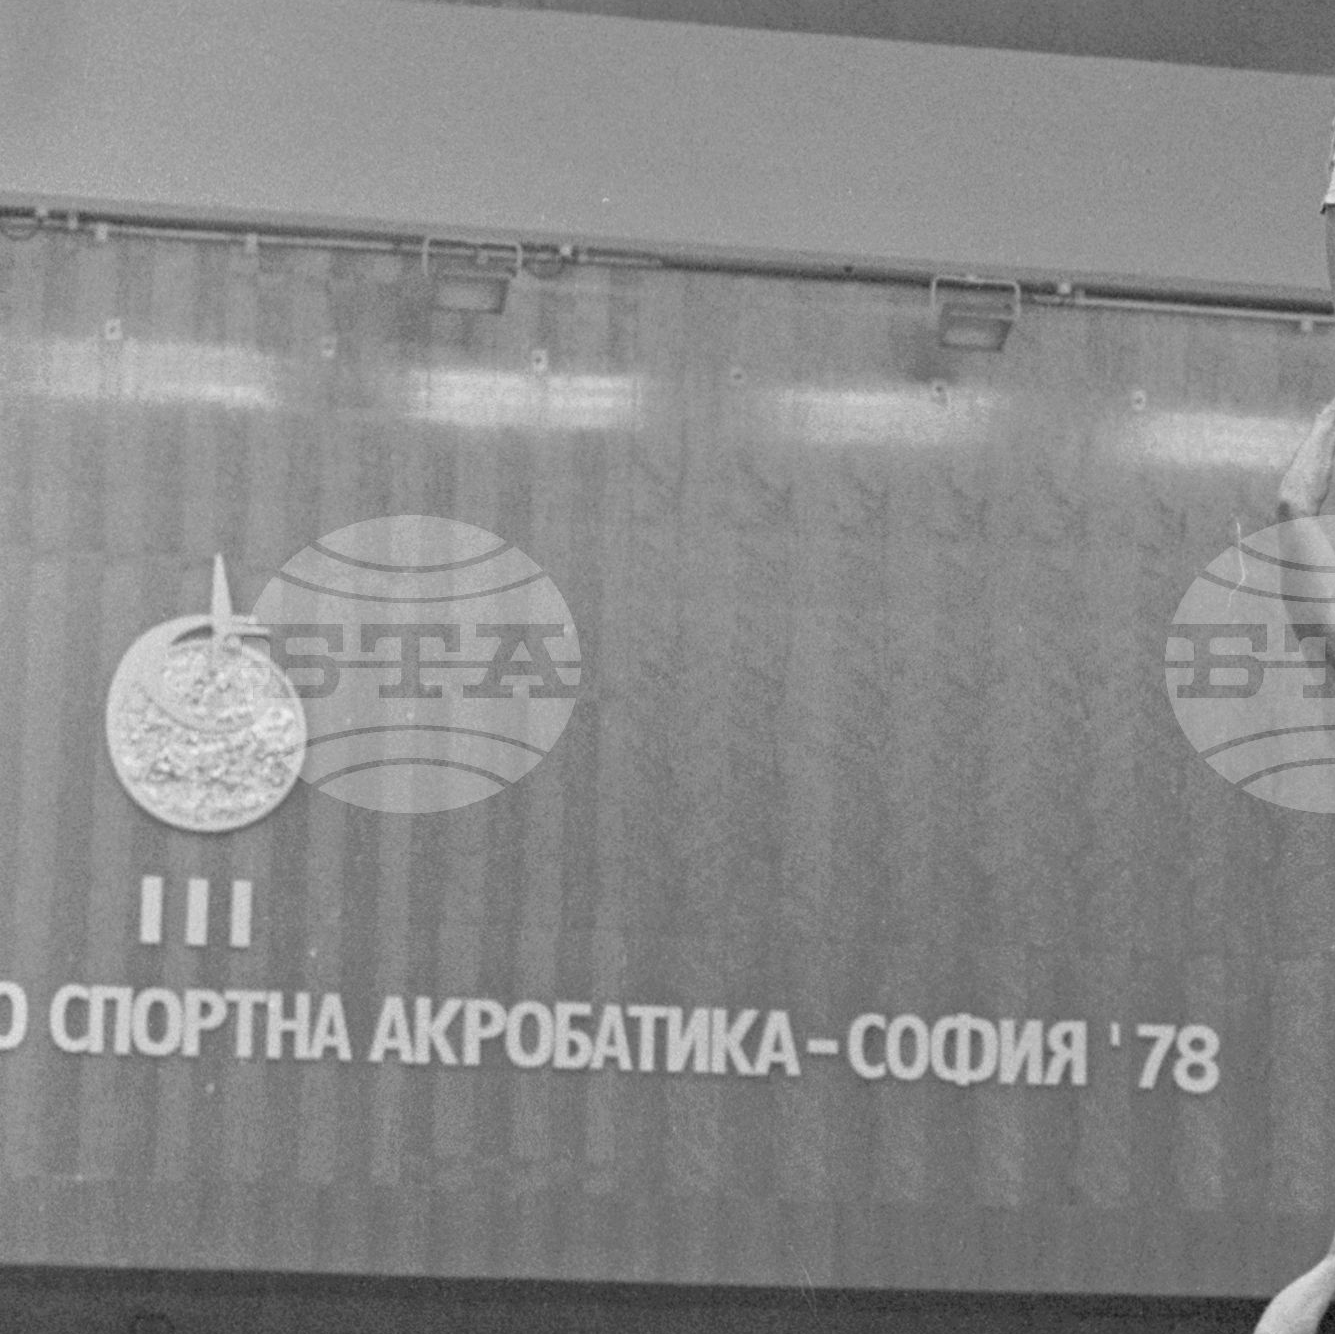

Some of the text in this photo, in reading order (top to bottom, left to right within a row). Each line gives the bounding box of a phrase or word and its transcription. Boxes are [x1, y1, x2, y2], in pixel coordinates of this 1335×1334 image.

[139, 875, 253, 948] III
[49, 984, 352, 1061] СПОРТНА
[1110, 1022, 1220, 1093] '78
